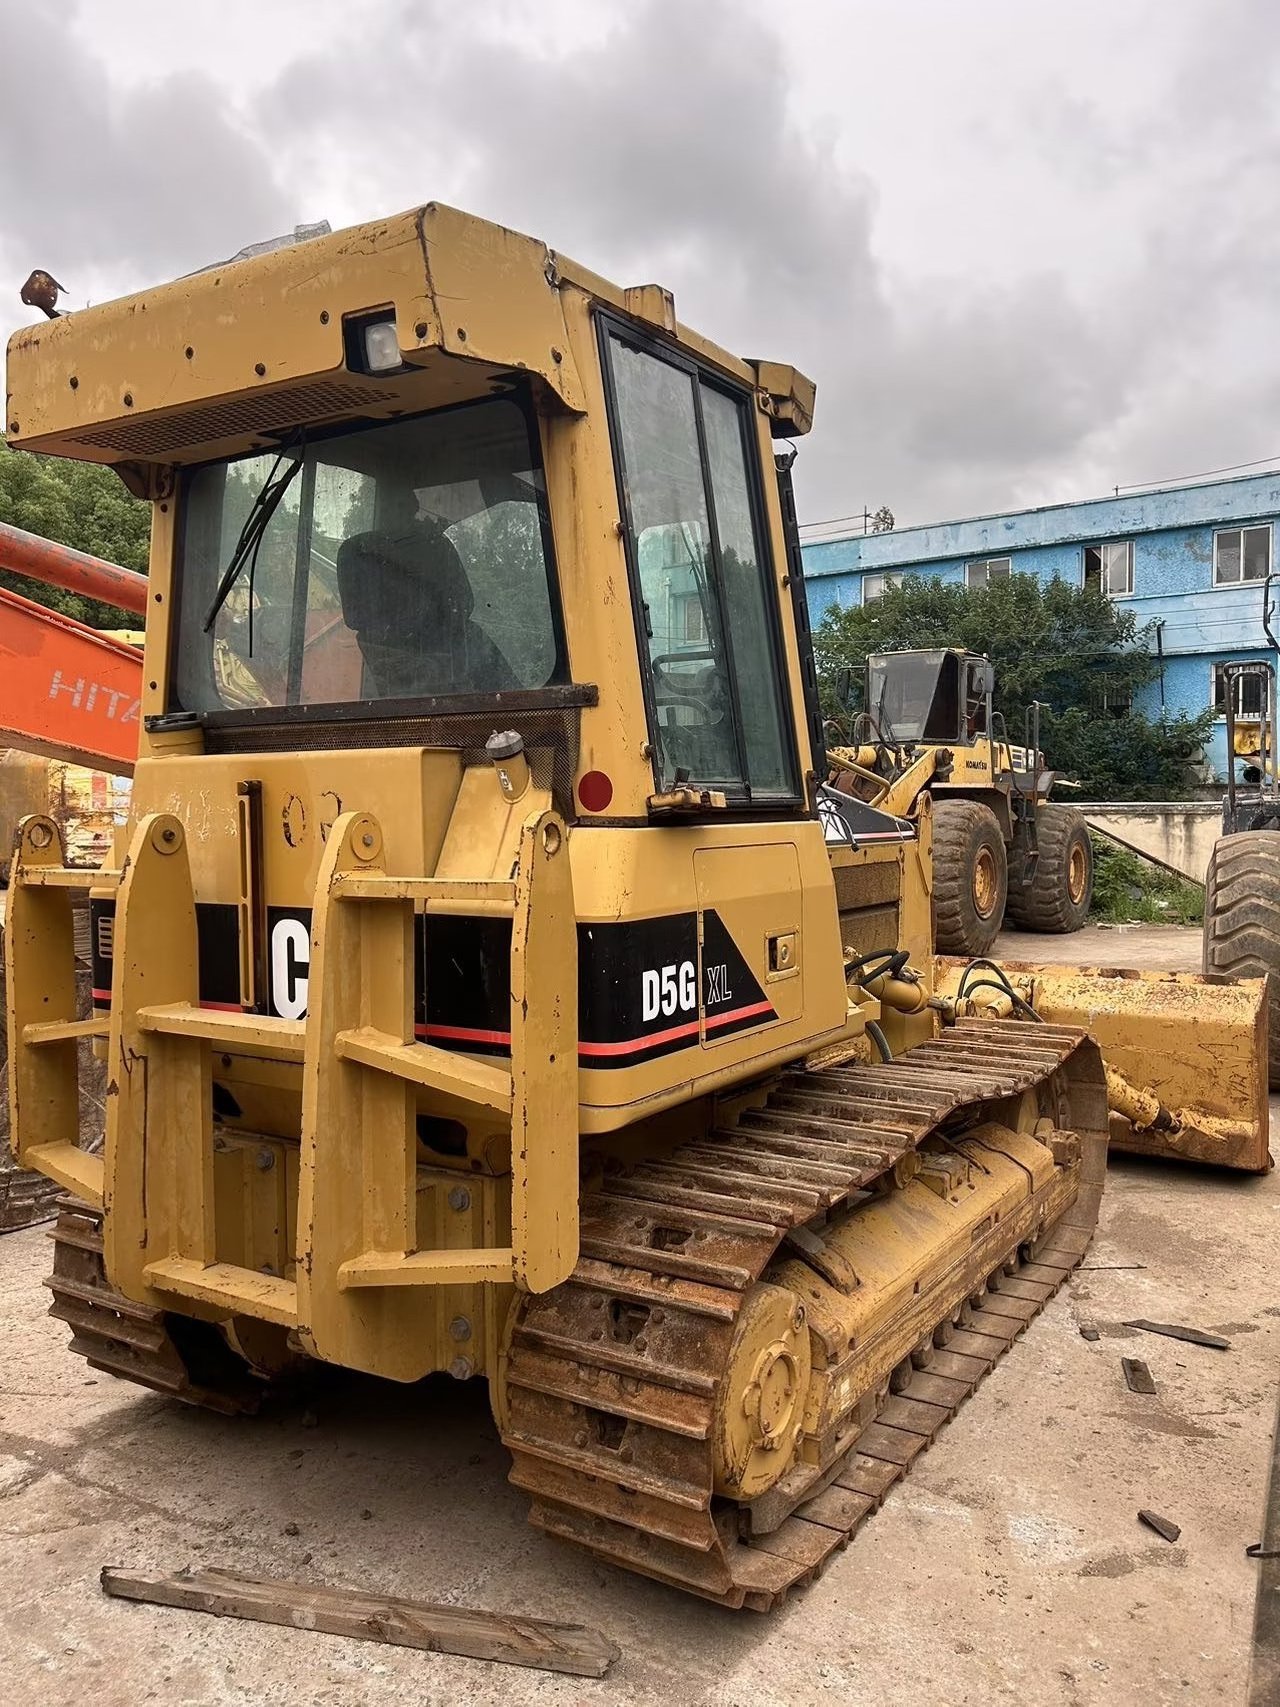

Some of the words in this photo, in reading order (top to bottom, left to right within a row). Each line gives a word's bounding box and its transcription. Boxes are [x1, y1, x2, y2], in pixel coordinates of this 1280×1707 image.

[965, 759, 988, 770] KOMATSU
[642, 960, 697, 1022] D5G
[706, 964, 732, 1005] XL
